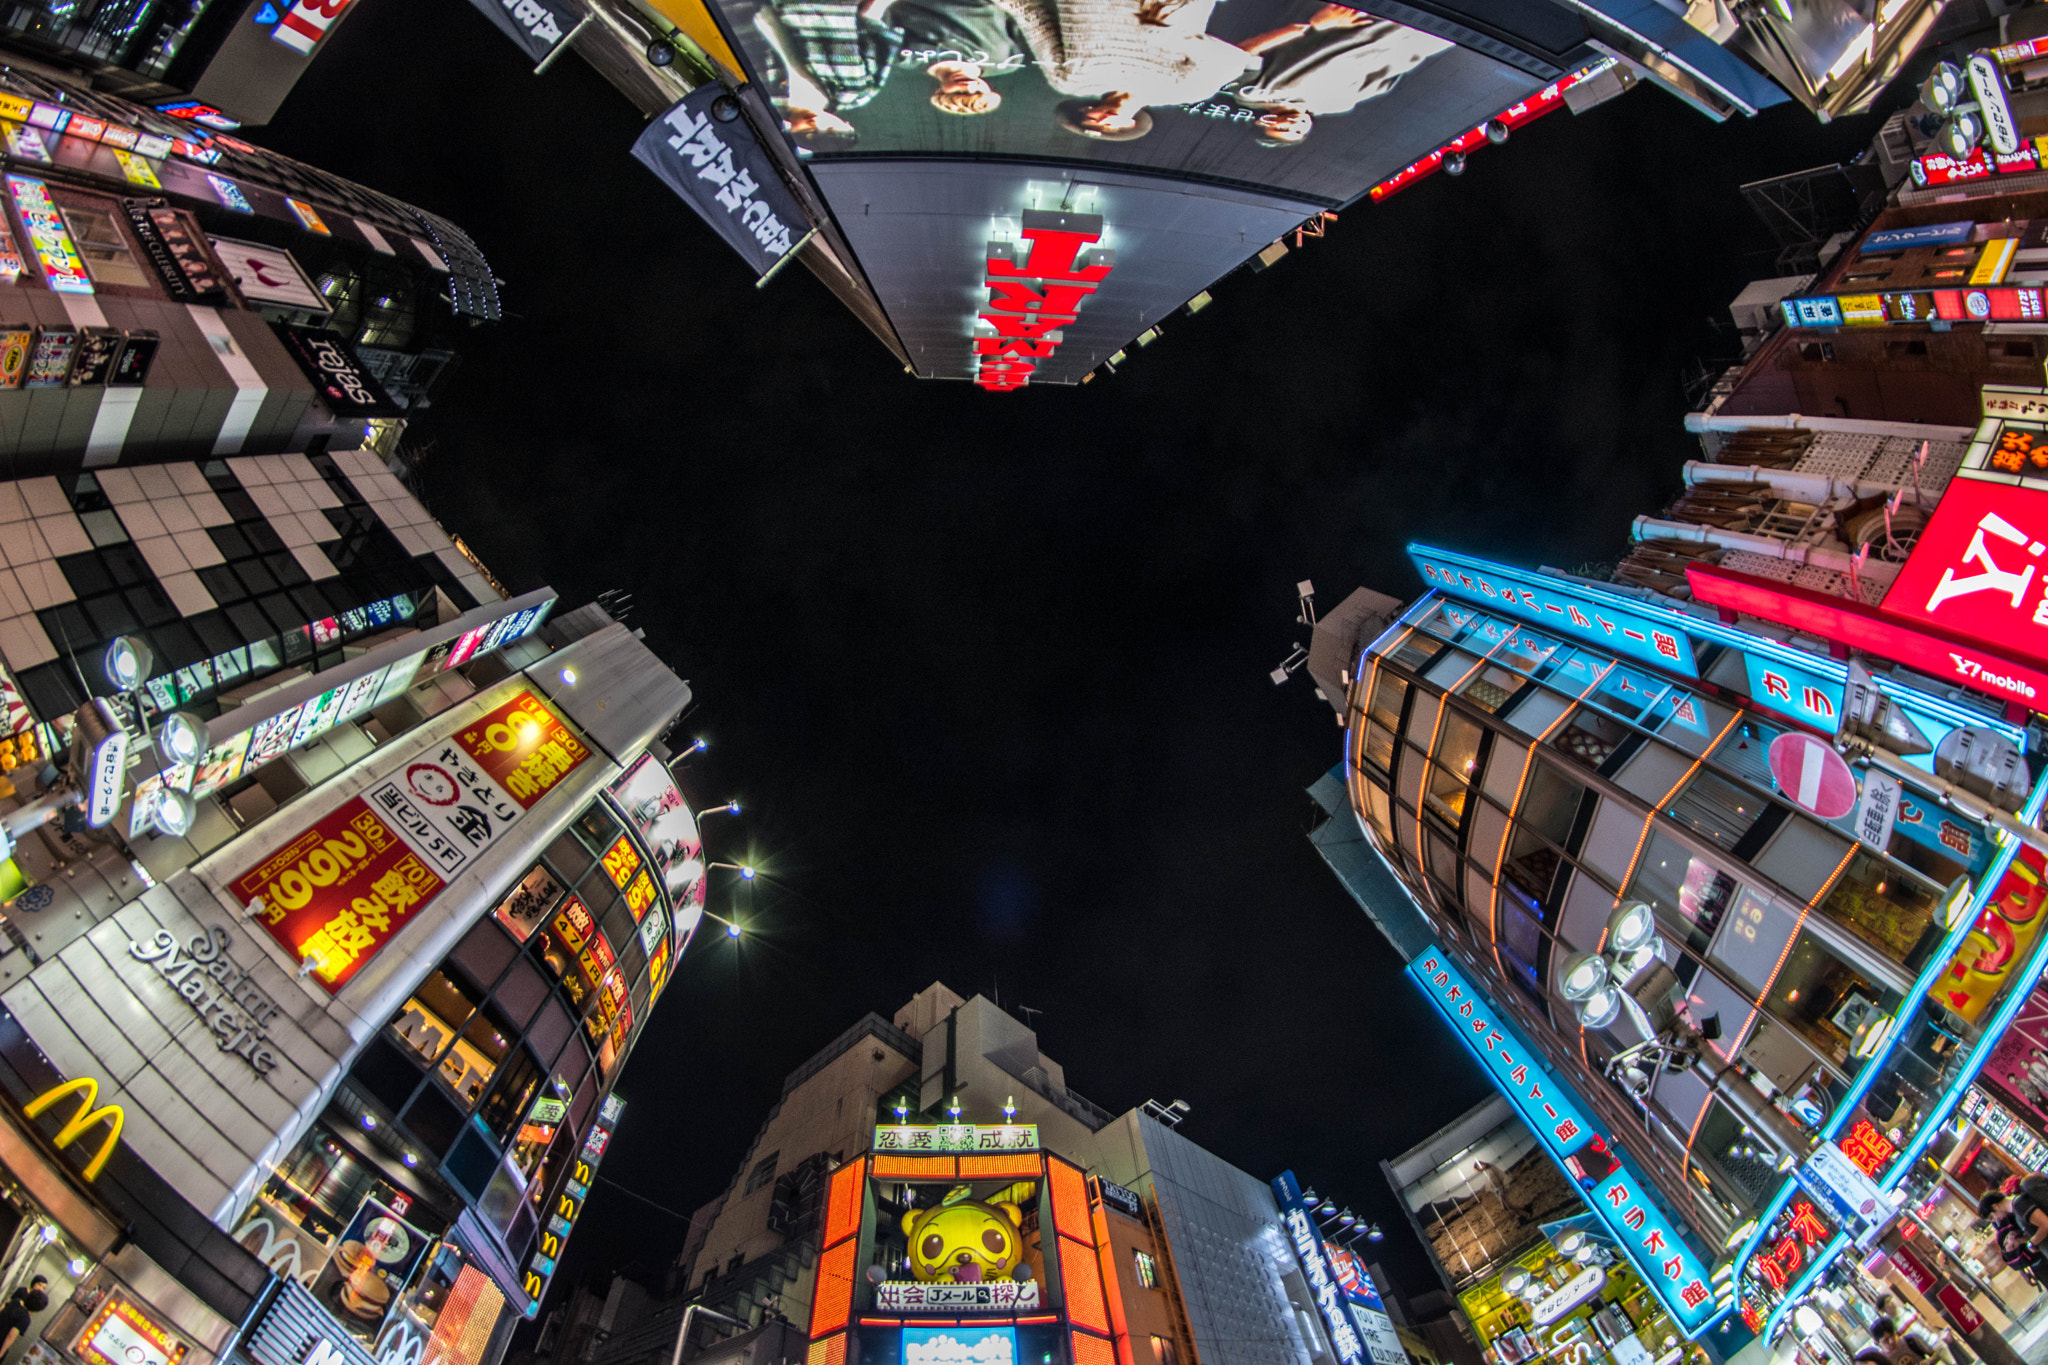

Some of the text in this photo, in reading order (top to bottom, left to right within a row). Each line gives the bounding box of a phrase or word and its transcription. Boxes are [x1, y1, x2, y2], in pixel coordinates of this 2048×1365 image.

[1804, 302, 1834, 319] 麻雀
[307, 338, 376, 405] rejas
[1981, 669, 2036, 699] mobile
[438, 747, 516, 822] やきとり
[506, 741, 577, 800] 串焼き
[1865, 781, 1893, 847] 自転車を除く
[269, 830, 367, 912] 299
[128, 928, 278, 1076] Marejie
[188, 924, 280, 1029] Saint
[1422, 958, 1579, 1143] カラオケ&パーティー館
[879, 1130, 1034, 1150] 恋愛 成就
[1605, 1185, 1713, 1309] カラオケ館
[882, 1285, 925, 1304] 出会
[930, 1289, 975, 1302] Jメール
[1286, 1207, 1362, 1365] カラオケの鉄
[1356, 1310, 1374, 1327] YOU
[1365, 1327, 1381, 1344] ARE
